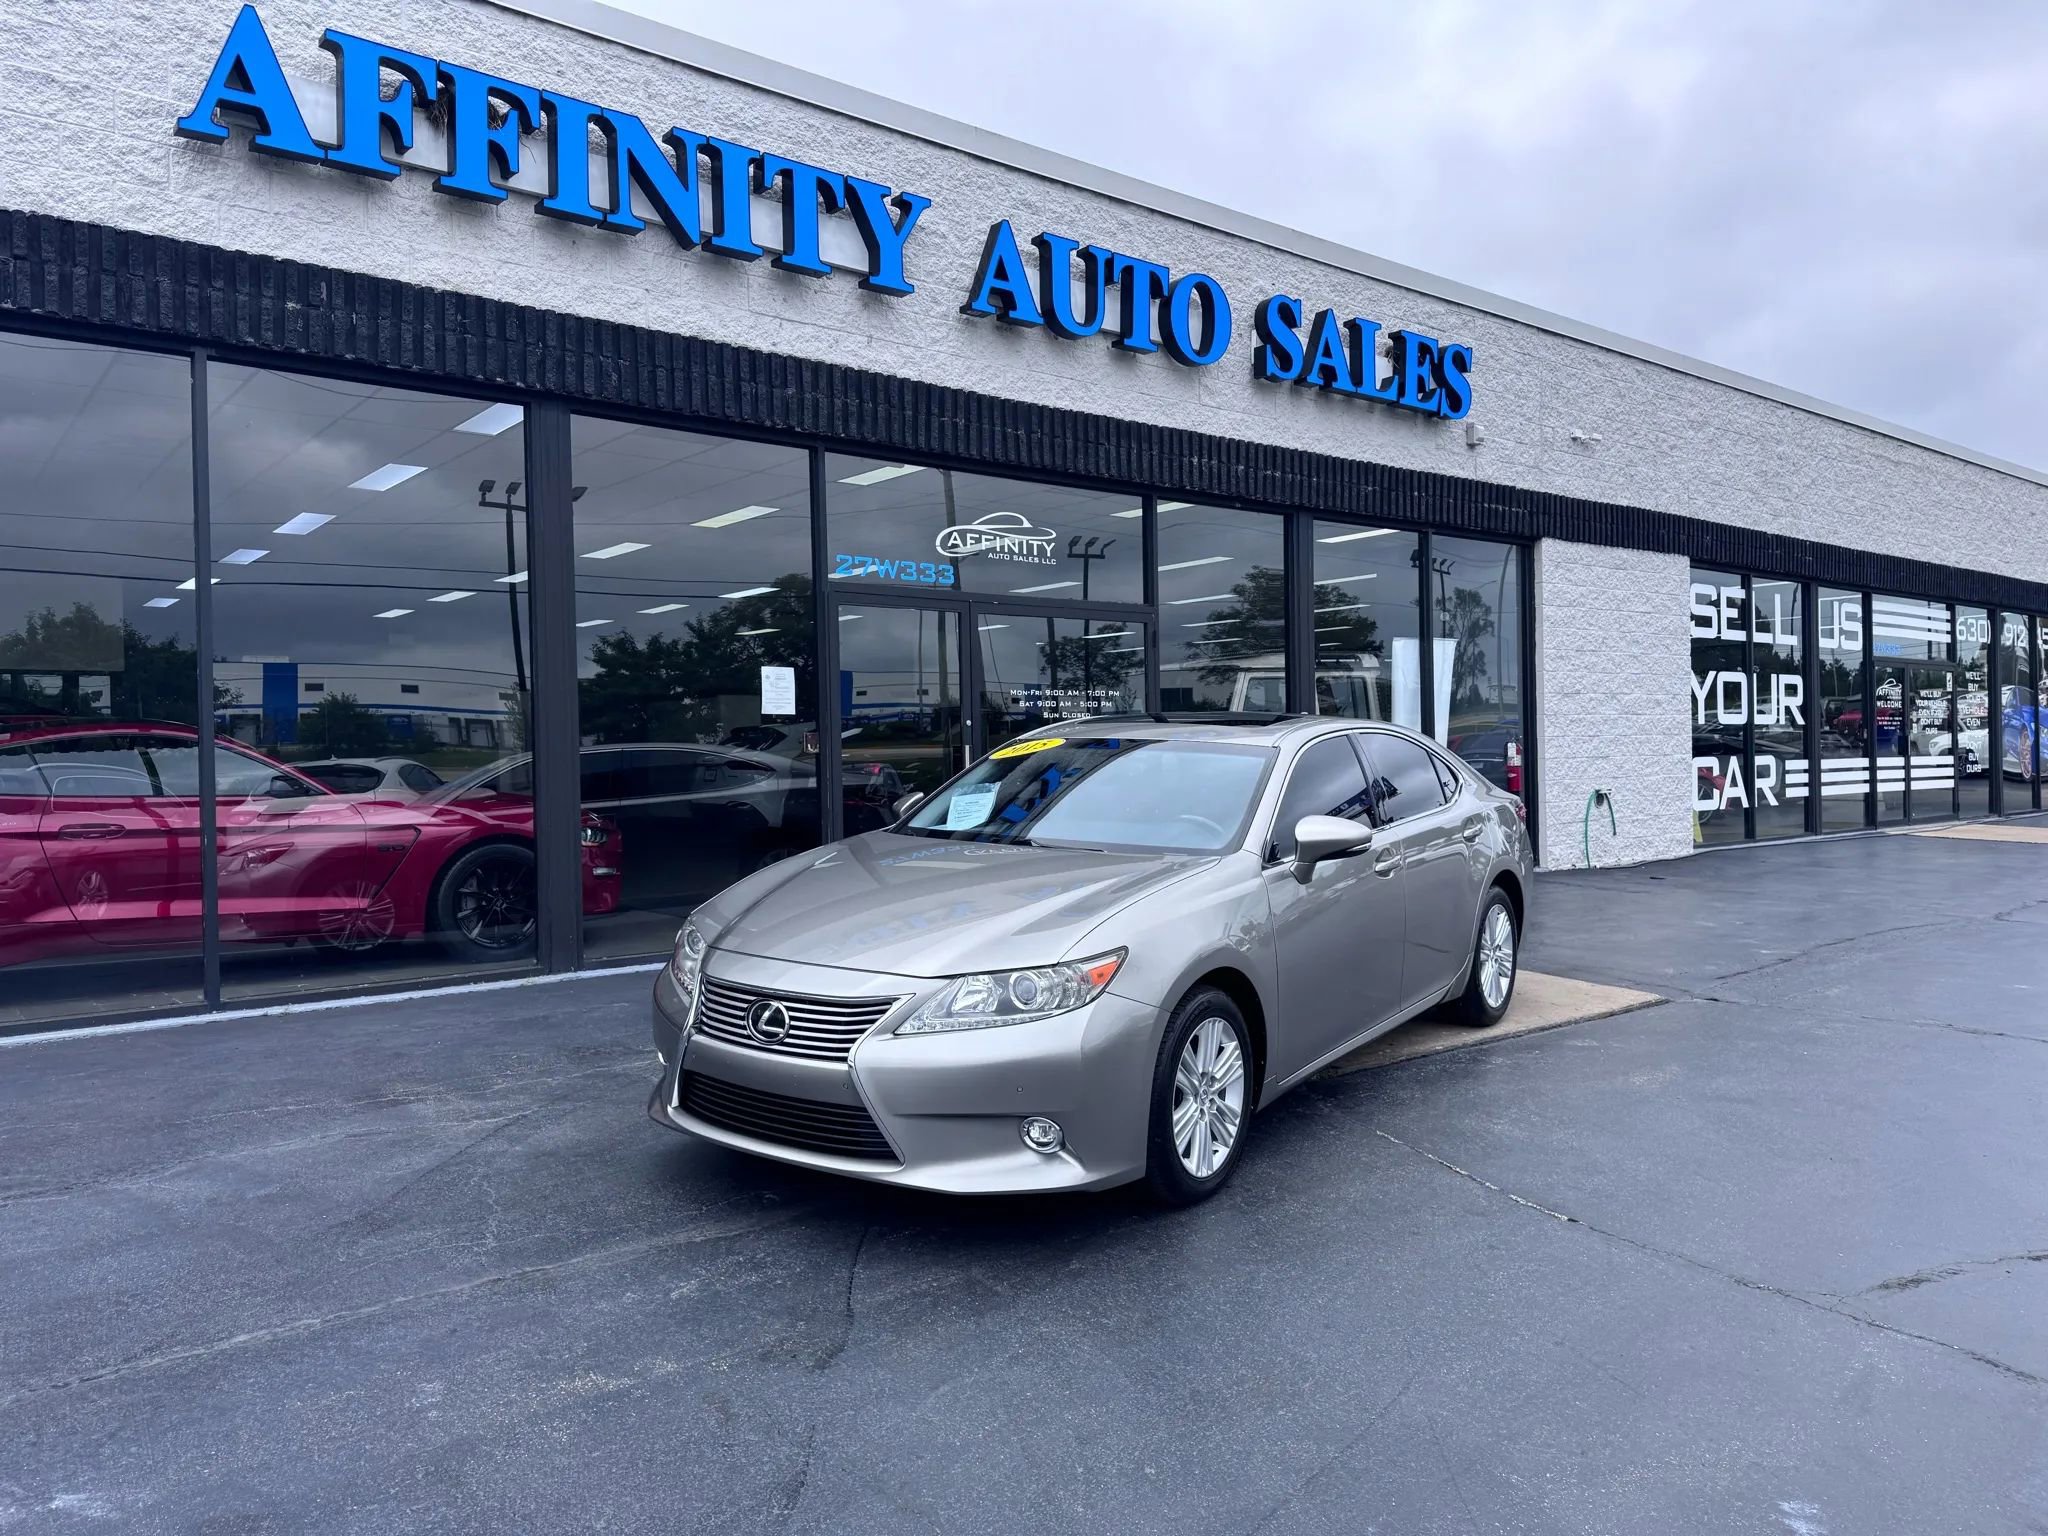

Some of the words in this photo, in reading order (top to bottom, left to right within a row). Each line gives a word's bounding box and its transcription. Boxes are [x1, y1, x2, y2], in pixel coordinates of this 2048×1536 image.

[174, 4, 931, 295] AFFINITY
[959, 219, 1232, 367] AUTO
[1254, 295, 1472, 419] SALES
[947, 531, 1056, 557] AFFINITY
[835, 553, 955, 585] 27W333
[987, 552, 1010, 561] AUTO
[1013, 555, 1039, 563] SALES
[1690, 583, 1798, 646] SELL
[1819, 600, 1863, 651] US
[2003, 623, 2027, 647] 912
[1691, 671, 1805, 725] YOUR
[1876, 700, 1903, 709] WELCOME
[1966, 718, 1981, 727] EVEN
[1966, 764, 1982, 773] OURS
[1968, 752, 1980, 762] BUY
[1692, 754, 1779, 812] CAR
